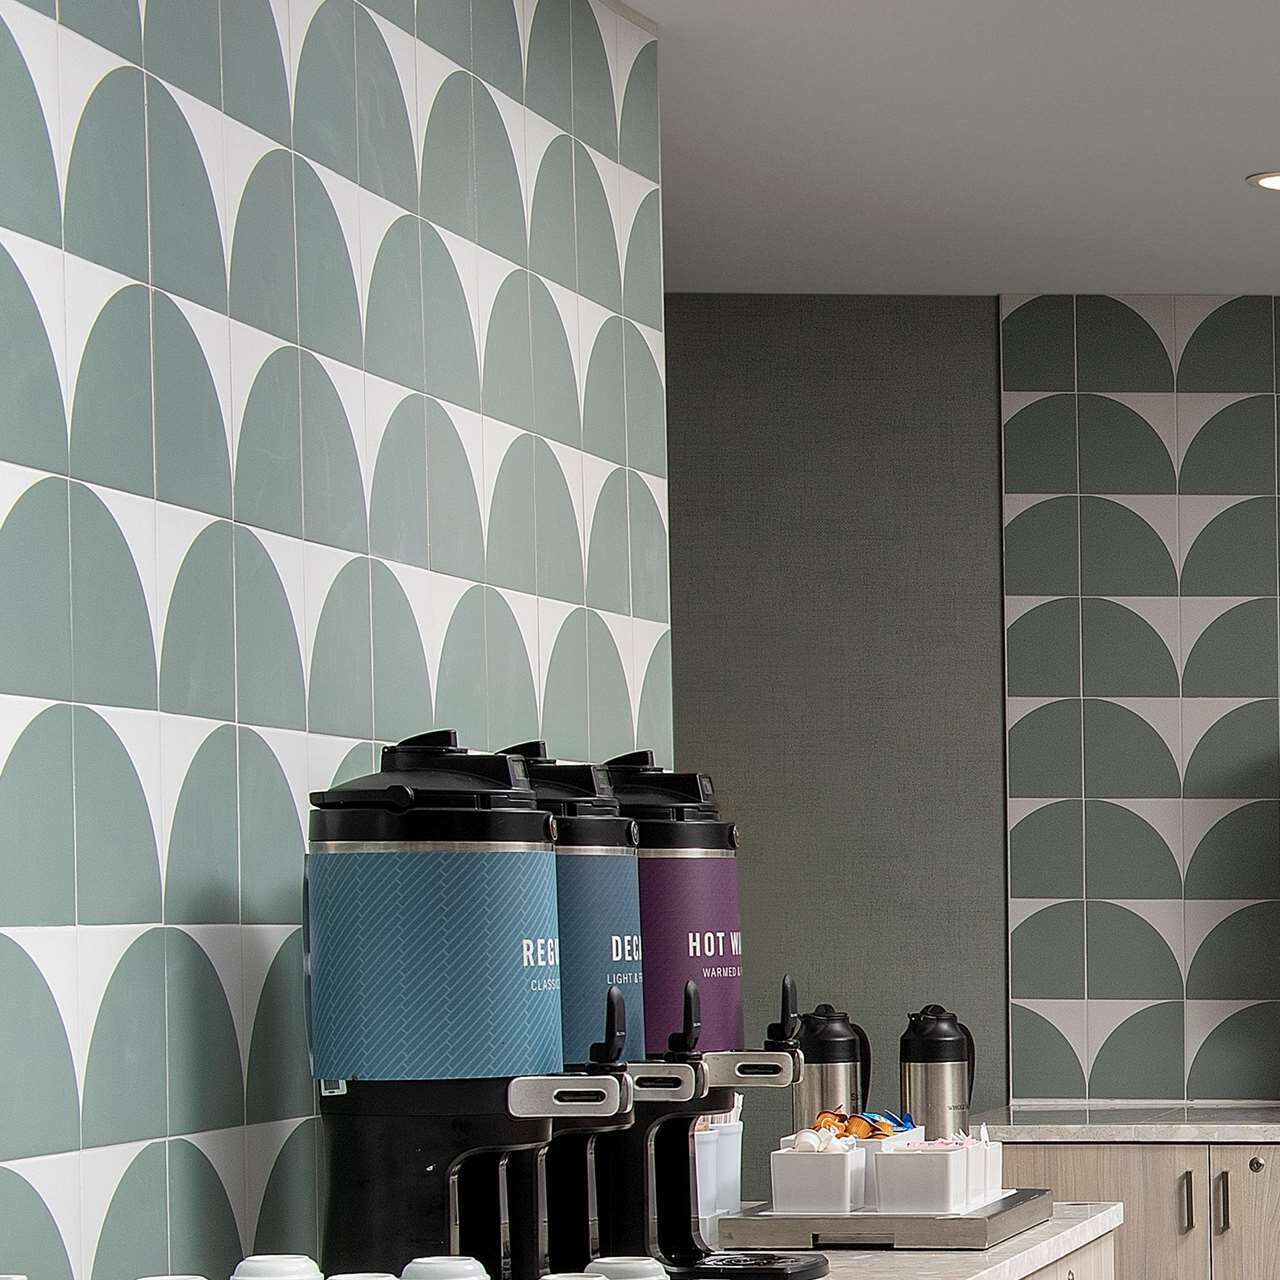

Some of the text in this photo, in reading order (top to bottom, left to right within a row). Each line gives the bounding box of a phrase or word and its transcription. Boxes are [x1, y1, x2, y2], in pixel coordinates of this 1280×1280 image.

[611, 935, 642, 961] DEC
[688, 932, 725, 957] HOT
[606, 972, 632, 985] LIGHT
[702, 966, 736, 977] WARMED
